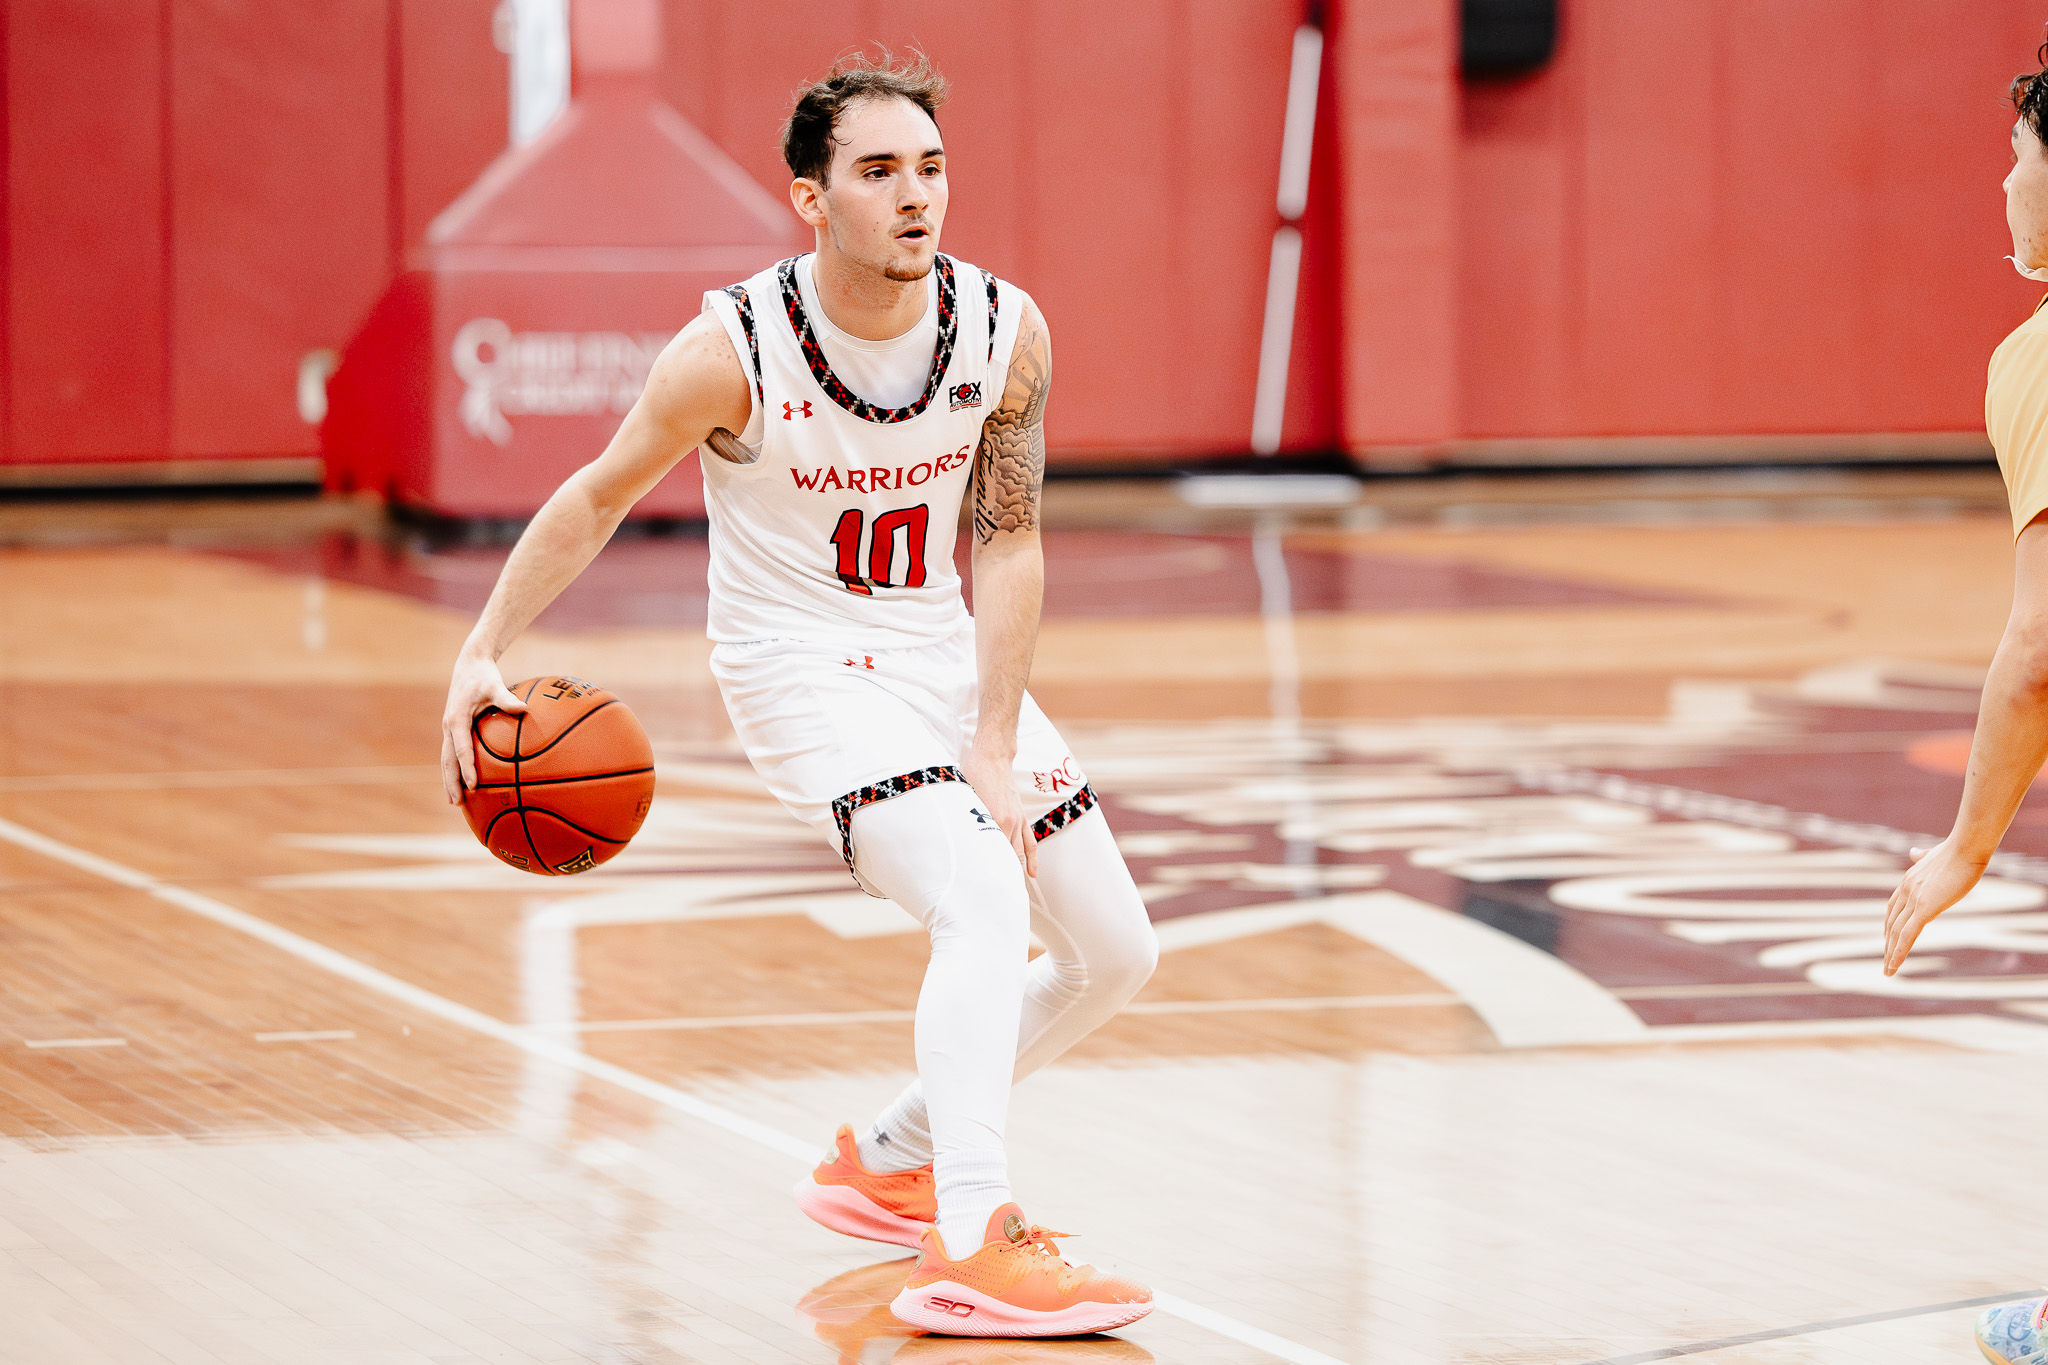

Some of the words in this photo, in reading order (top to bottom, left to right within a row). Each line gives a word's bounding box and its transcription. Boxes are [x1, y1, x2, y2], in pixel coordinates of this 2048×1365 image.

[949, 381, 981, 403] FOX
[790, 445, 970, 493] WARRIORS
[830, 503, 929, 595] 10
